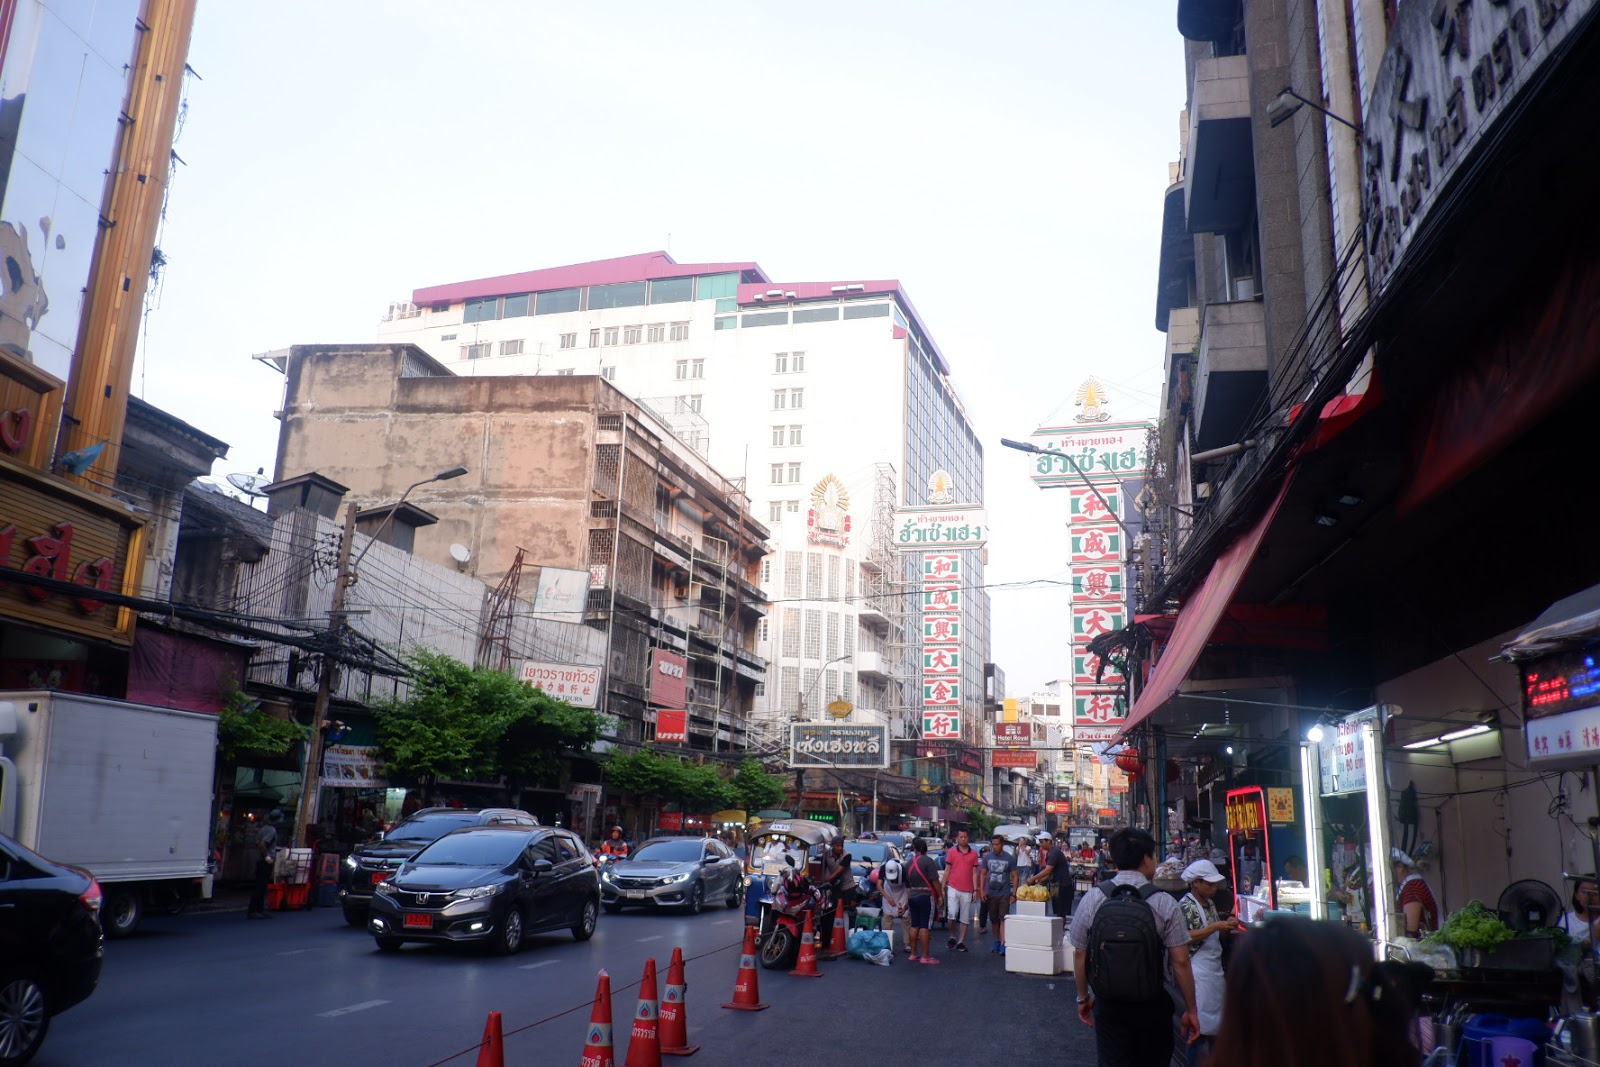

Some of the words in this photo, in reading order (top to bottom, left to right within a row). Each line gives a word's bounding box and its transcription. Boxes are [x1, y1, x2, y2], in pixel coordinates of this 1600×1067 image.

[1061, 436, 1123, 447] ห้างขายทอง
[1036, 442, 1153, 474] ฮั่วเซ่งเฮง
[899, 519, 982, 542] ฮั่วเซ่งเฮง
[525, 667, 598, 684] เยาวราชทัวร์
[796, 735, 881, 754] เซ่งเฮงหลี
